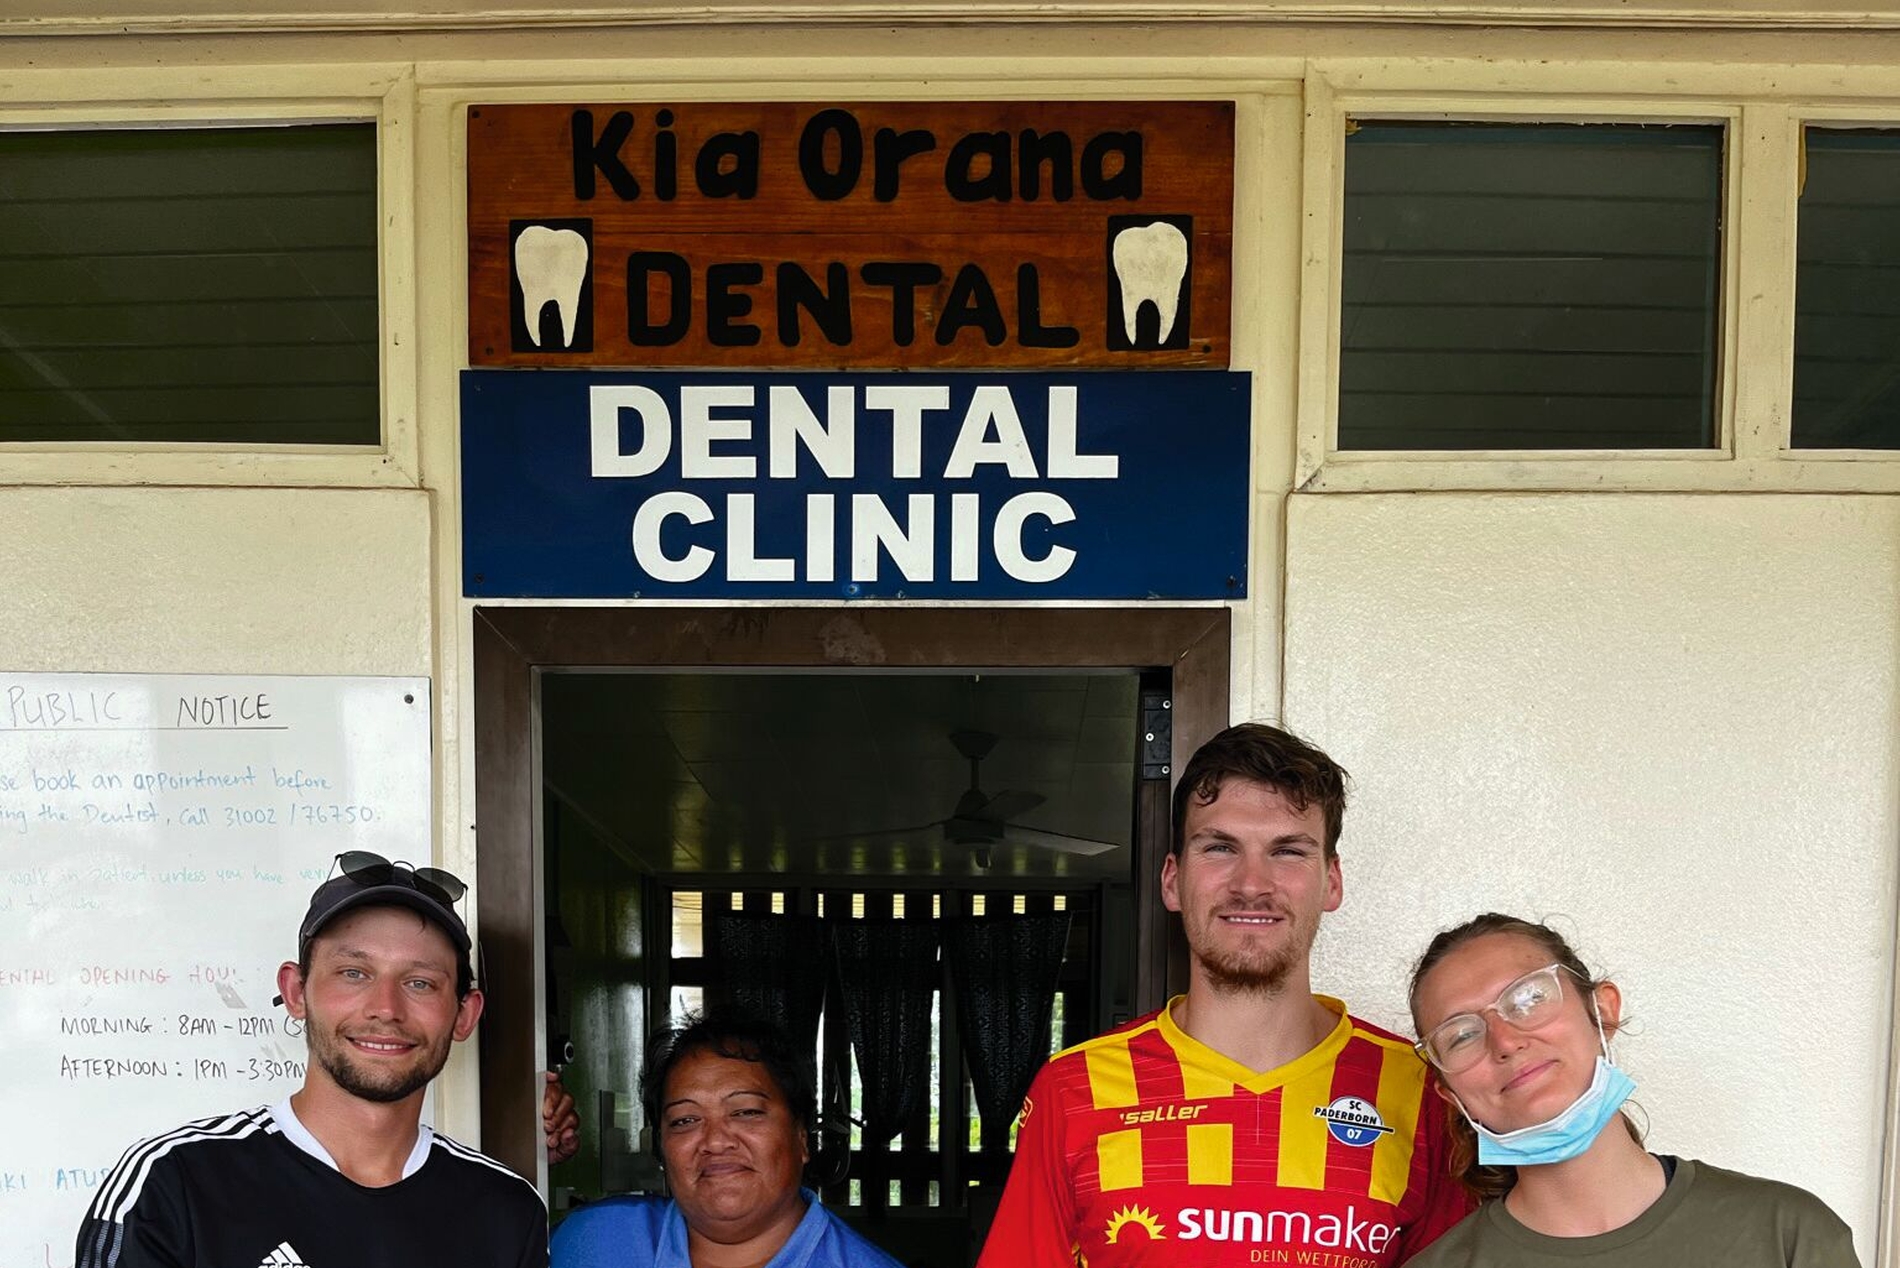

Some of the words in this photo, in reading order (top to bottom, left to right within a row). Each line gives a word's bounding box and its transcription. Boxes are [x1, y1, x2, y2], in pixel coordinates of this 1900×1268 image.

[571, 106, 760, 202] Kia
[799, 107, 1143, 202] Orana
[627, 251, 1080, 348] DENTAL
[589, 385, 1119, 479] DENTAL
[632, 491, 1078, 583] CLINIC
[8, 685, 121, 727] PUBLIC
[177, 694, 271, 727] NOTICE
[32, 769, 80, 791] book
[92, 774, 122, 790] an
[133, 766, 256, 796] appointment
[272, 768, 332, 797] before
[38, 803, 69, 821] the
[224, 806, 277, 827] 31002
[80, 966, 171, 987] OPENING
[61, 1016, 153, 1036] MORNING
[178, 1014, 217, 1036] 8AM
[238, 1016, 275, 1037] 12PM
[61, 1054, 168, 1081] AFTERNOON
[194, 1058, 228, 1081] 1PM
[1313, 1107, 1377, 1126] PADERBORN
[1349, 1100, 1362, 1111] SC
[1346, 1128, 1363, 1140] 07
[1177, 1205, 1401, 1255] sunmaker
[1250, 1249, 1289, 1264] DEIN
